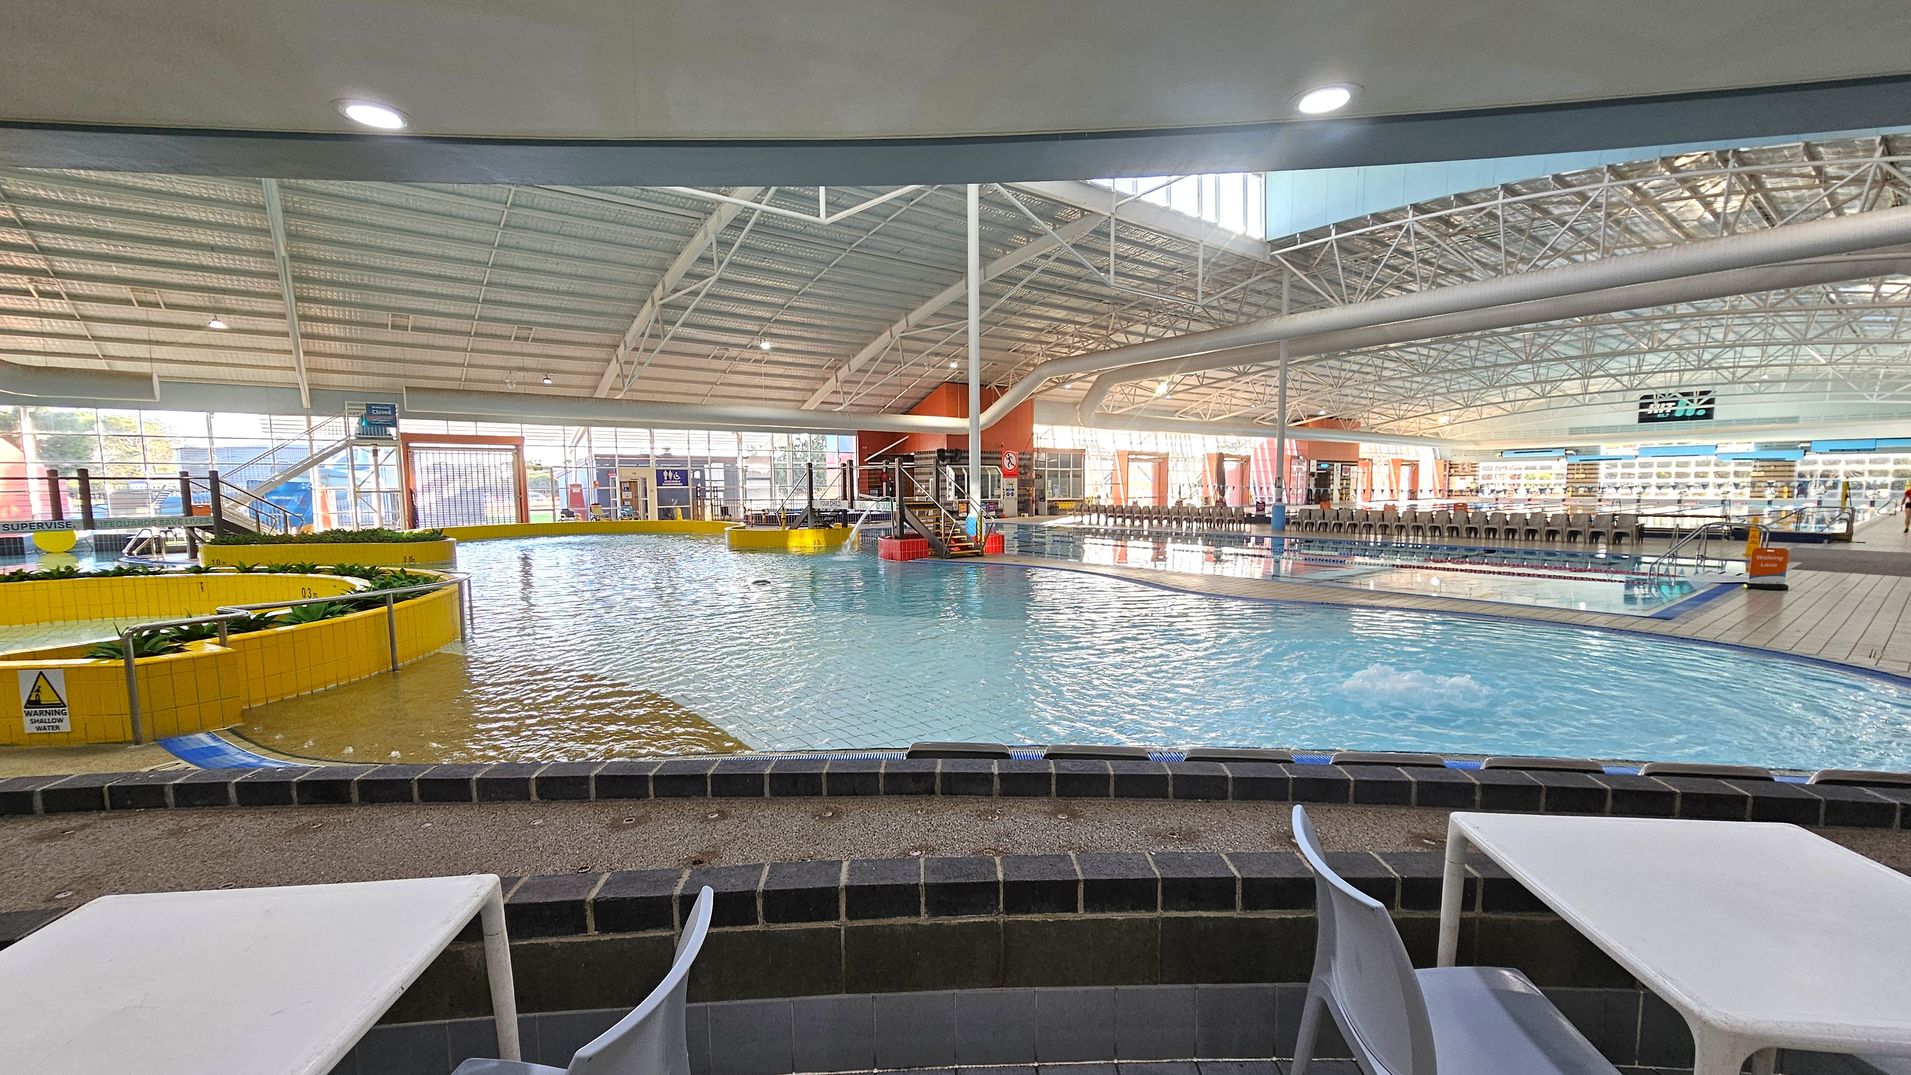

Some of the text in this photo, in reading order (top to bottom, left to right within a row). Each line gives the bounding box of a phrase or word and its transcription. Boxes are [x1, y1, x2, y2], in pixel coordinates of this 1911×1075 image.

[2, 521, 76, 531] SUPERVISE.
[159, 518, 183, 526] SAVE
[1756, 554, 1784, 562] Walking
[24, 709, 67, 717] WARNING
